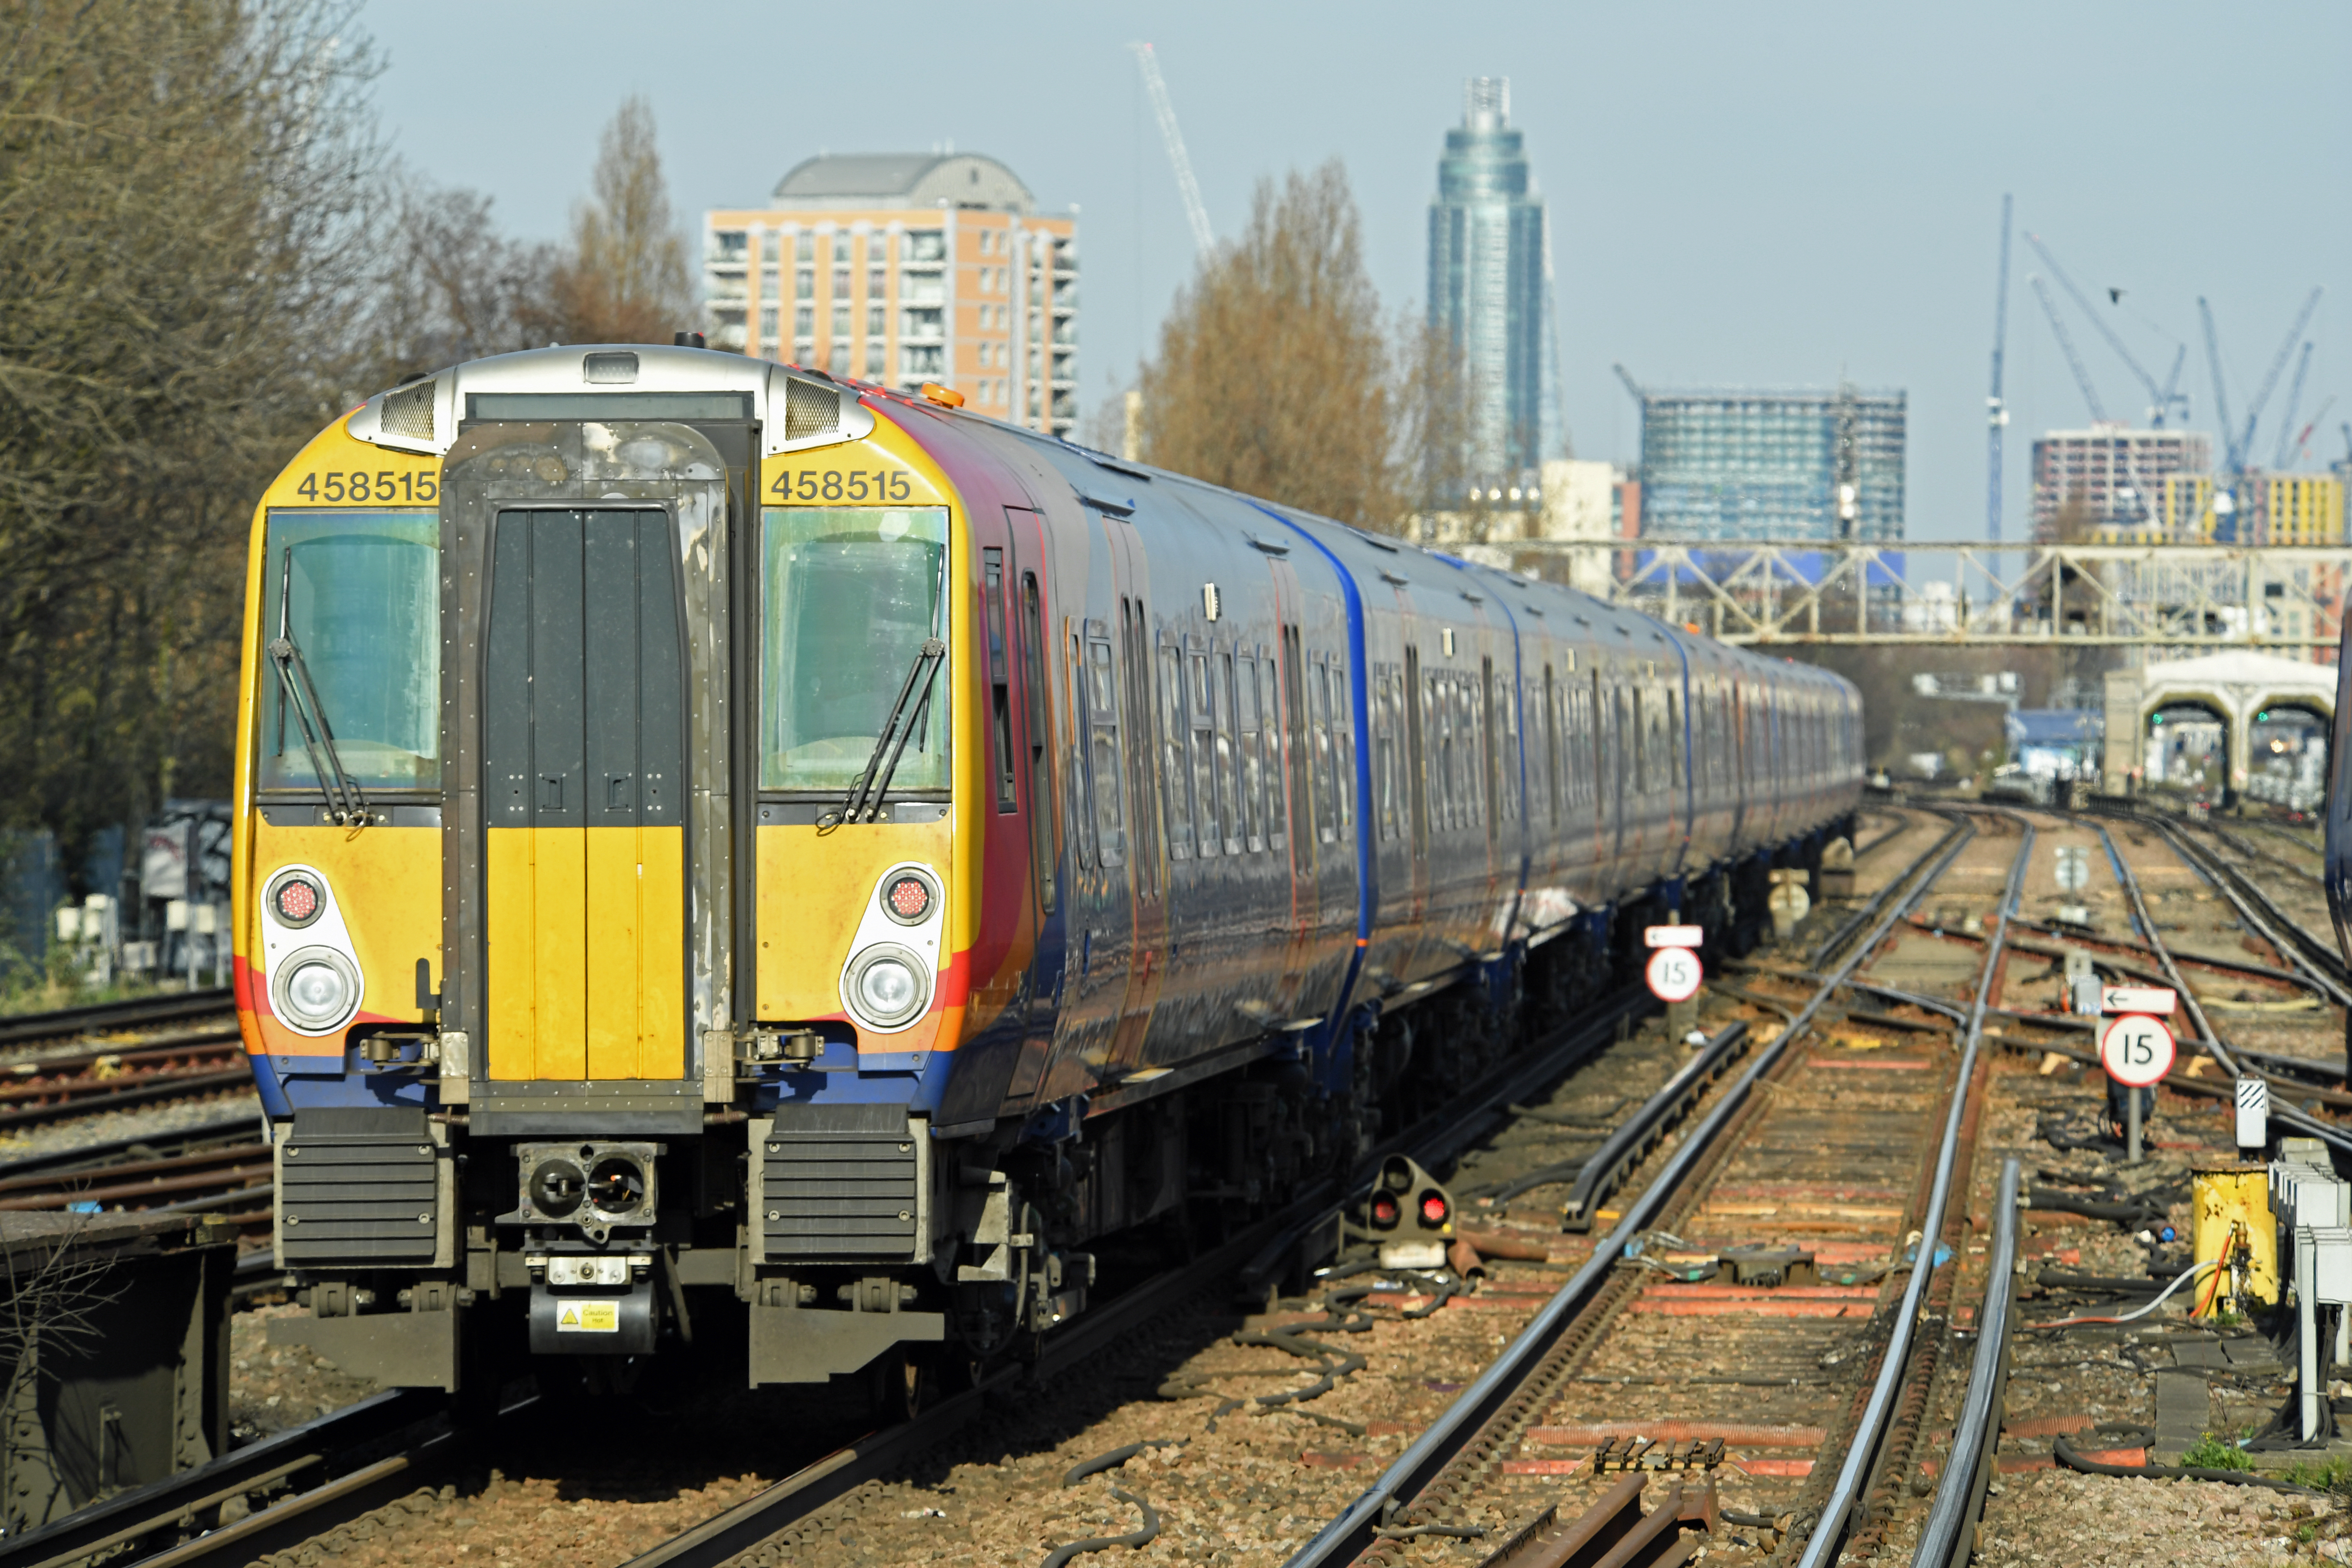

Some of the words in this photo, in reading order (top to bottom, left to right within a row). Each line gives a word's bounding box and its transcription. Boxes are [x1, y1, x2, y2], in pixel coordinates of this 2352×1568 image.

[297, 471, 437, 502] 458515
[771, 470, 911, 501] 458515
[1664, 961, 1687, 985] 15
[2125, 1034, 2153, 1065] 15
